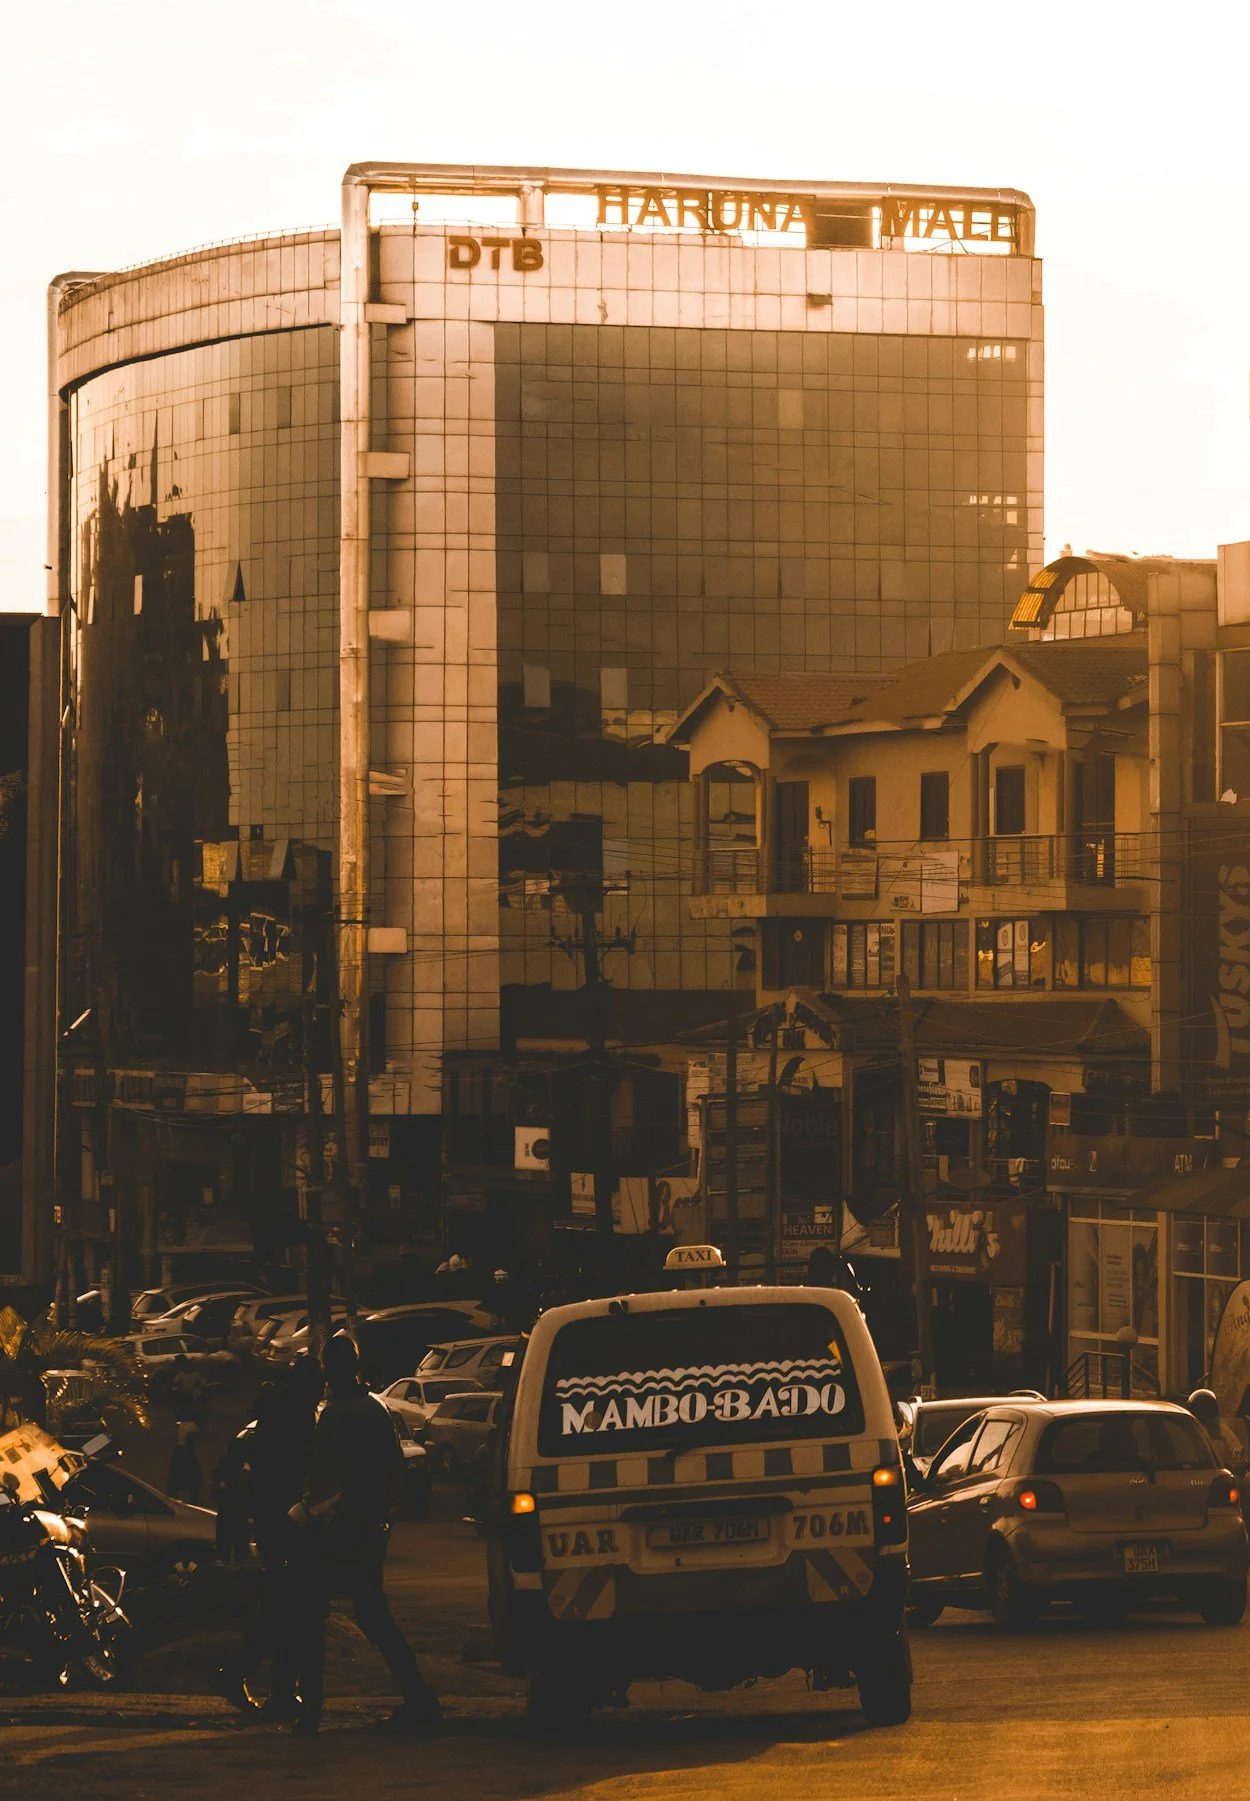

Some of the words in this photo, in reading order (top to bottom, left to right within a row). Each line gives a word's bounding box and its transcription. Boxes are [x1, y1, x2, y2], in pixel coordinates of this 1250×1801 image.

[597, 186, 807, 232] HARUNA
[448, 237, 544, 271] DTB
[1174, 1153, 1193, 1174] ATM
[784, 1224, 833, 1236] HEAVEN
[676, 1250, 712, 1263] TAXI
[793, 1510, 871, 1541] 706M
[547, 1529, 620, 1558] UAR
